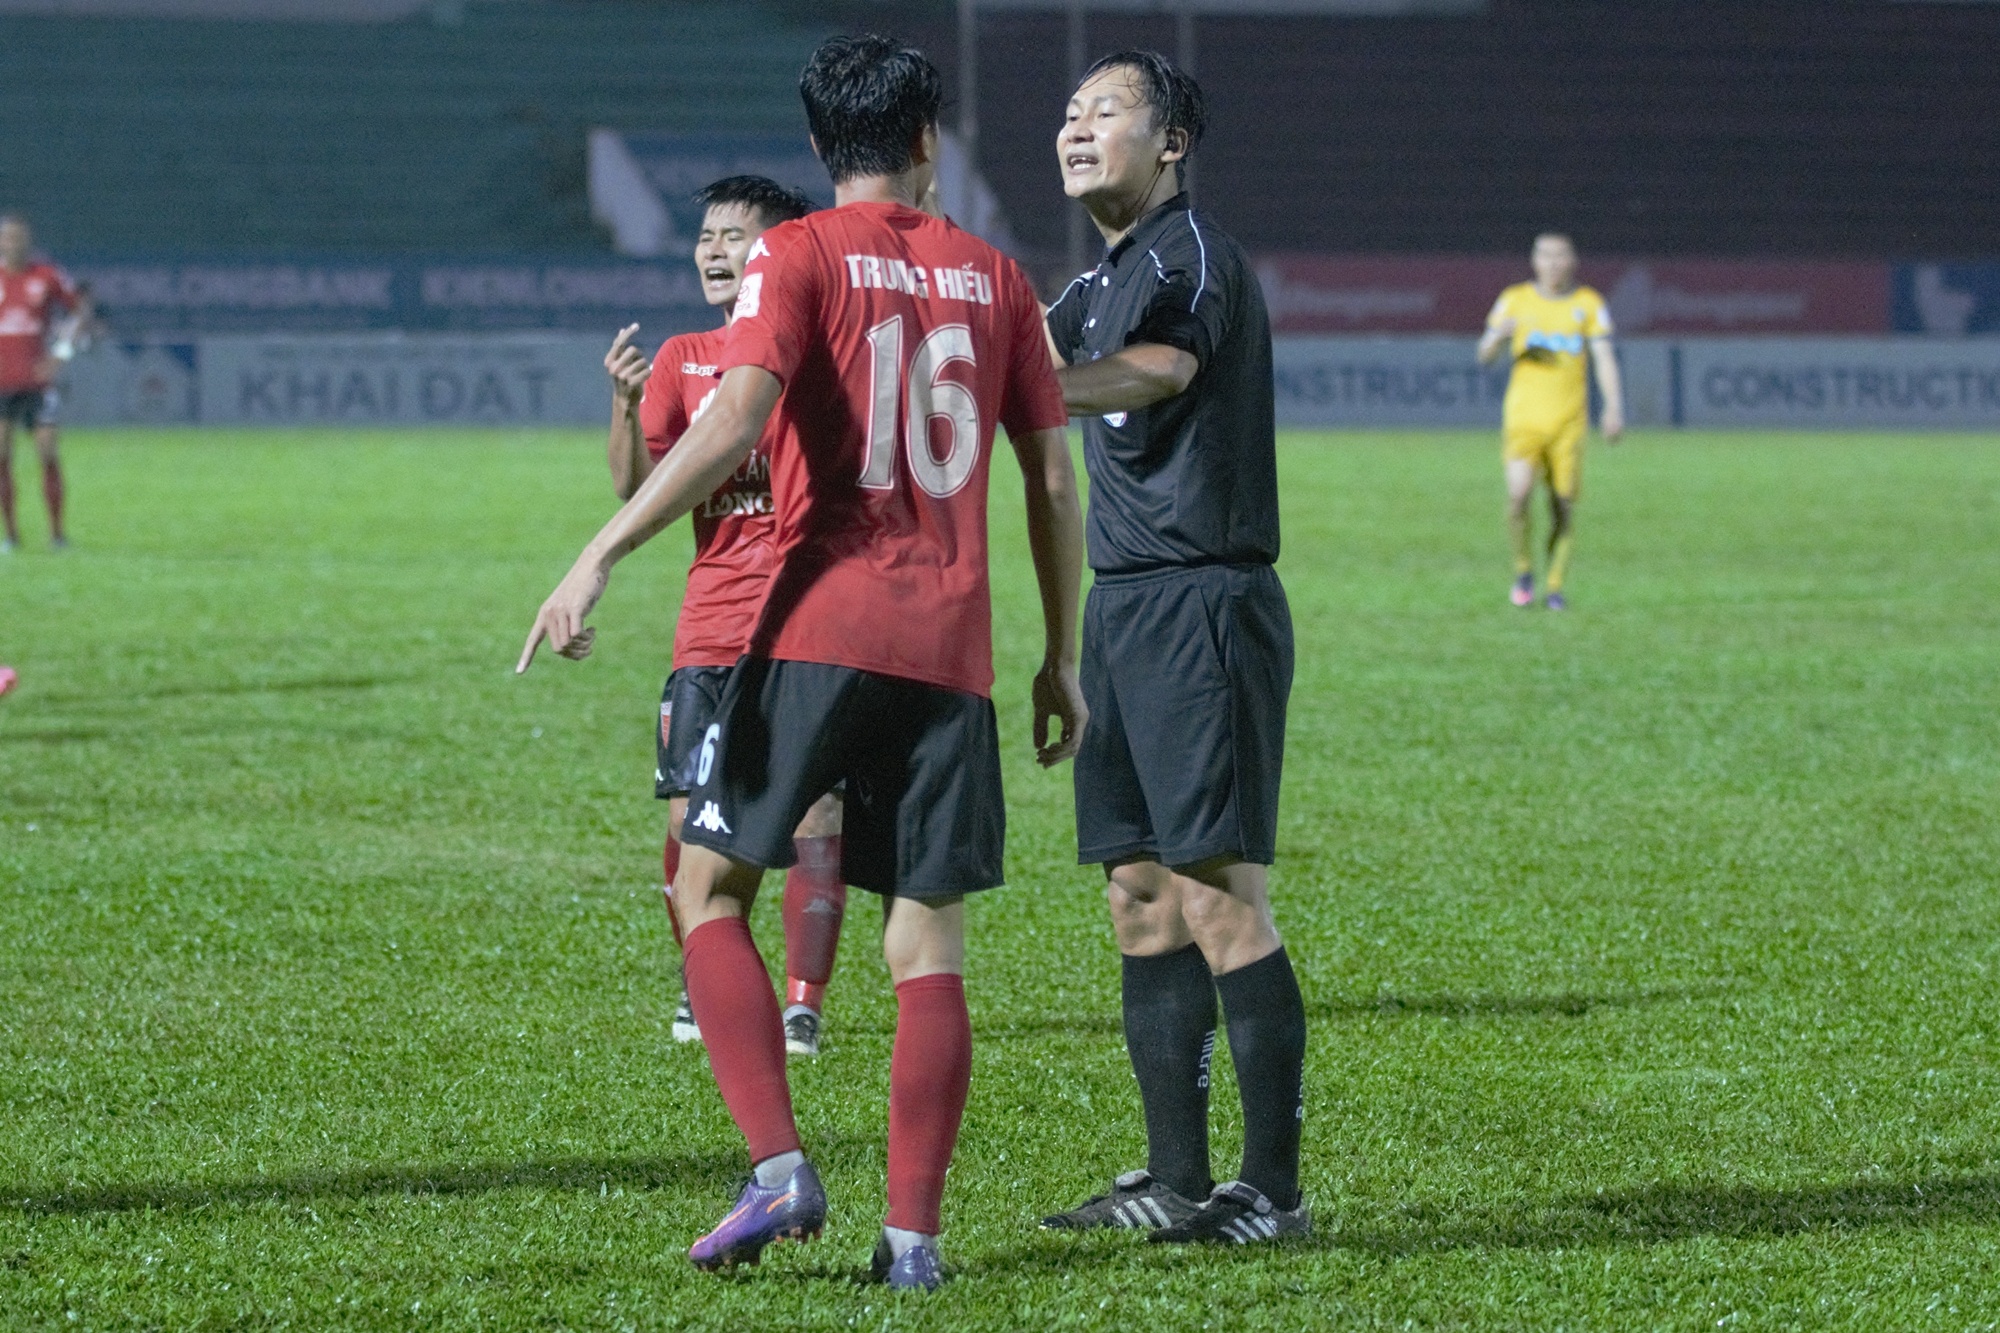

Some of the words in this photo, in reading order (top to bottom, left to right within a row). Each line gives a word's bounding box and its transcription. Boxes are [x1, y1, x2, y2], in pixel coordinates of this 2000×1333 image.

[845, 253, 929, 299] TRUNG
[933, 262, 993, 305] HIẾU
[857, 314, 981, 498] 16
[1197, 1029, 1217, 1088] mitre
